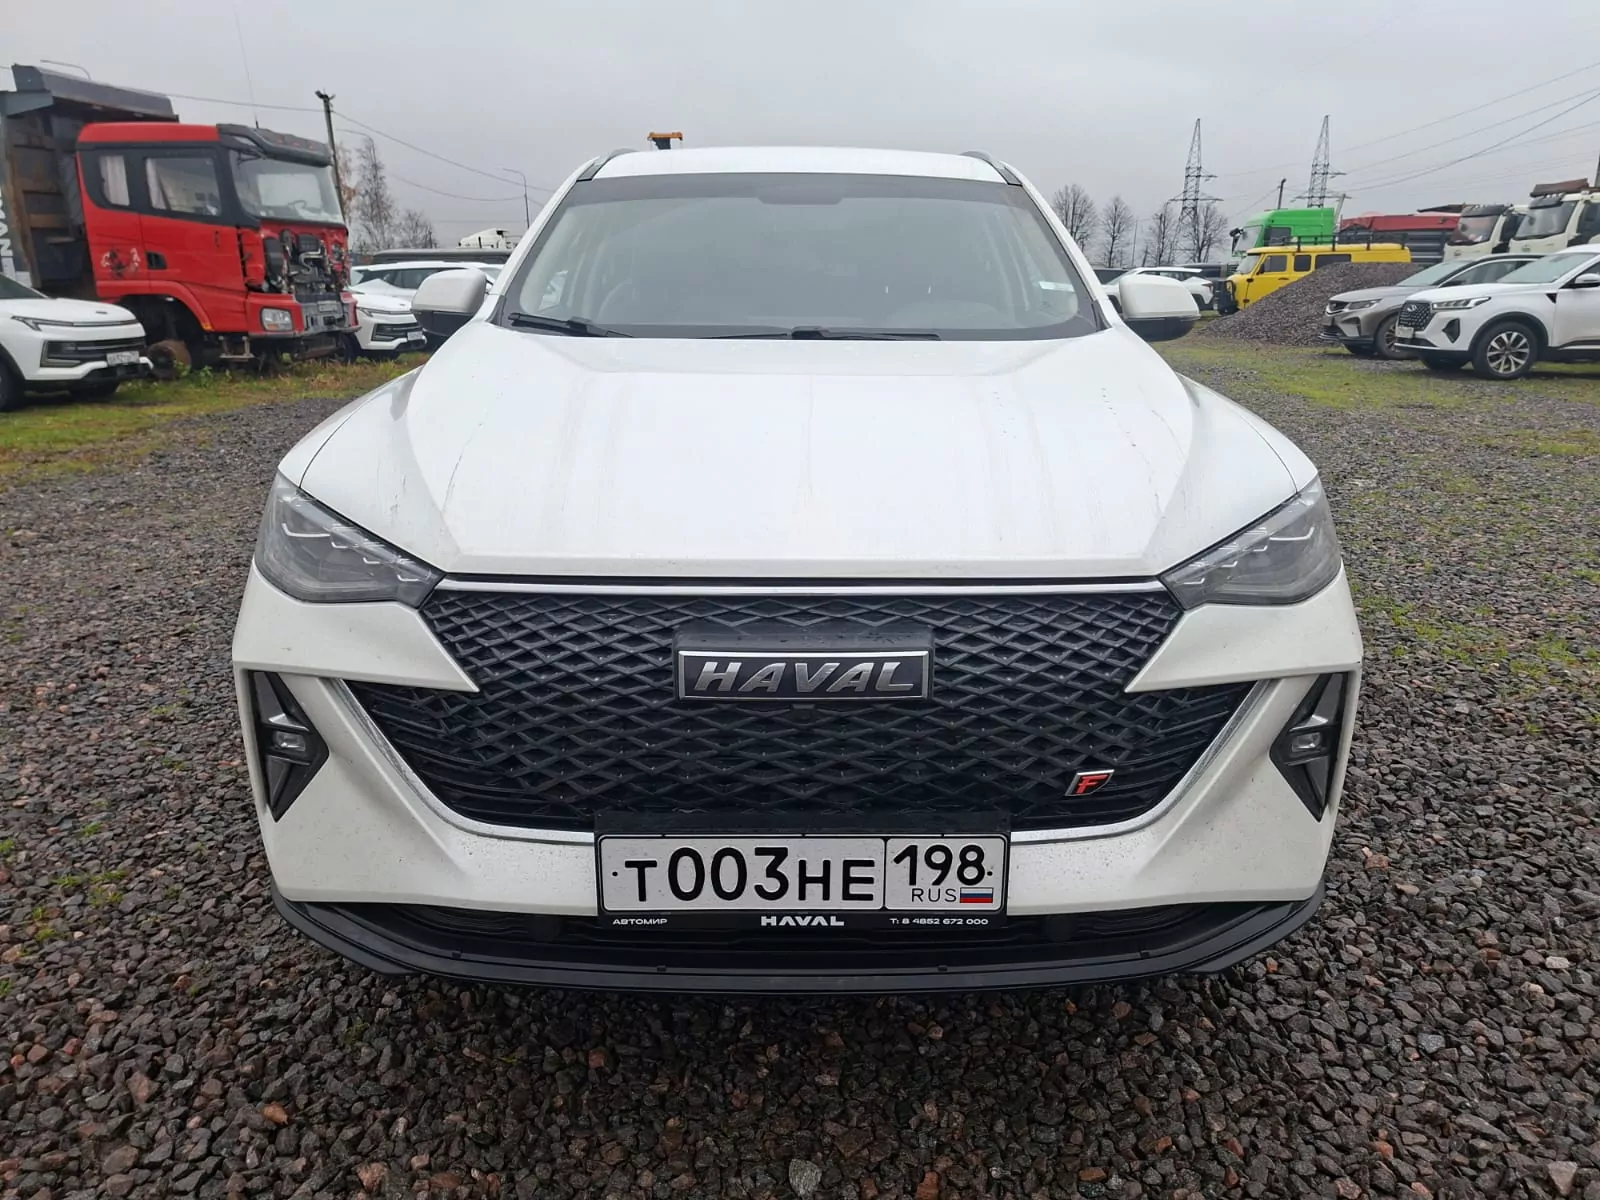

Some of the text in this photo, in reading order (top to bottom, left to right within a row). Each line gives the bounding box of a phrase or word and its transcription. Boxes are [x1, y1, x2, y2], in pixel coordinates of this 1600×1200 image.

[694, 661, 914, 693] HAVAL
[1076, 773, 1108, 794] F
[893, 844, 986, 887] 198
[911, 887, 957, 903] RUS
[612, 918, 668, 926] АВТОМИР
[761, 915, 845, 927] HAVAL
